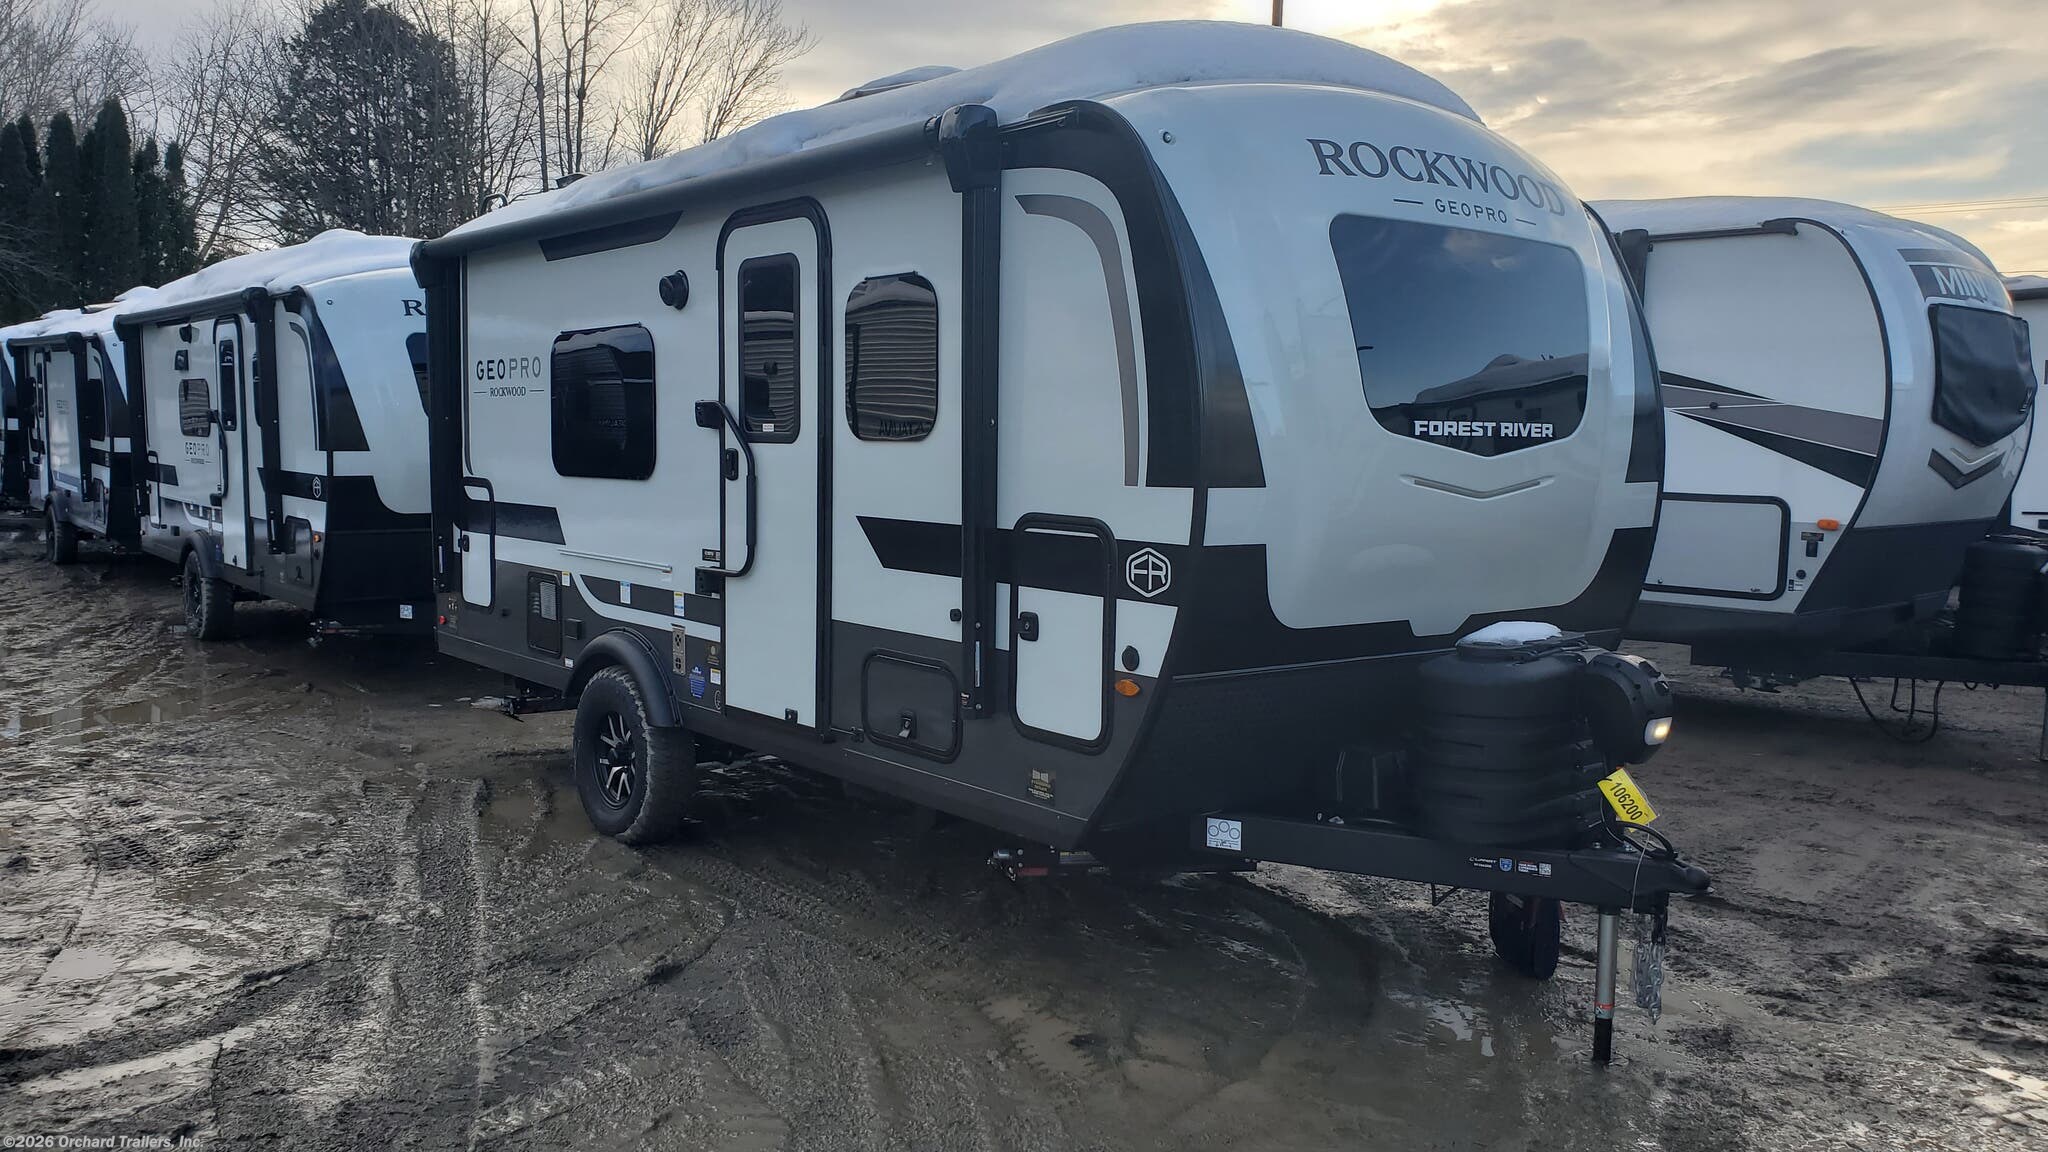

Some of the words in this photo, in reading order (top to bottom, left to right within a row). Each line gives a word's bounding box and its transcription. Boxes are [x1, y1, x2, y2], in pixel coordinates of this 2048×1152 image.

[1306, 138, 1566, 217] ROCKWOOD
[1434, 198, 1508, 224] GEOPRO
[476, 356, 541, 381] GEOPRO
[489, 386, 527, 397] ROCKWOOD
[1414, 420, 1497, 437] FOREST
[1500, 422, 1553, 438] RIVER
[1610, 782, 1643, 820] 106200
